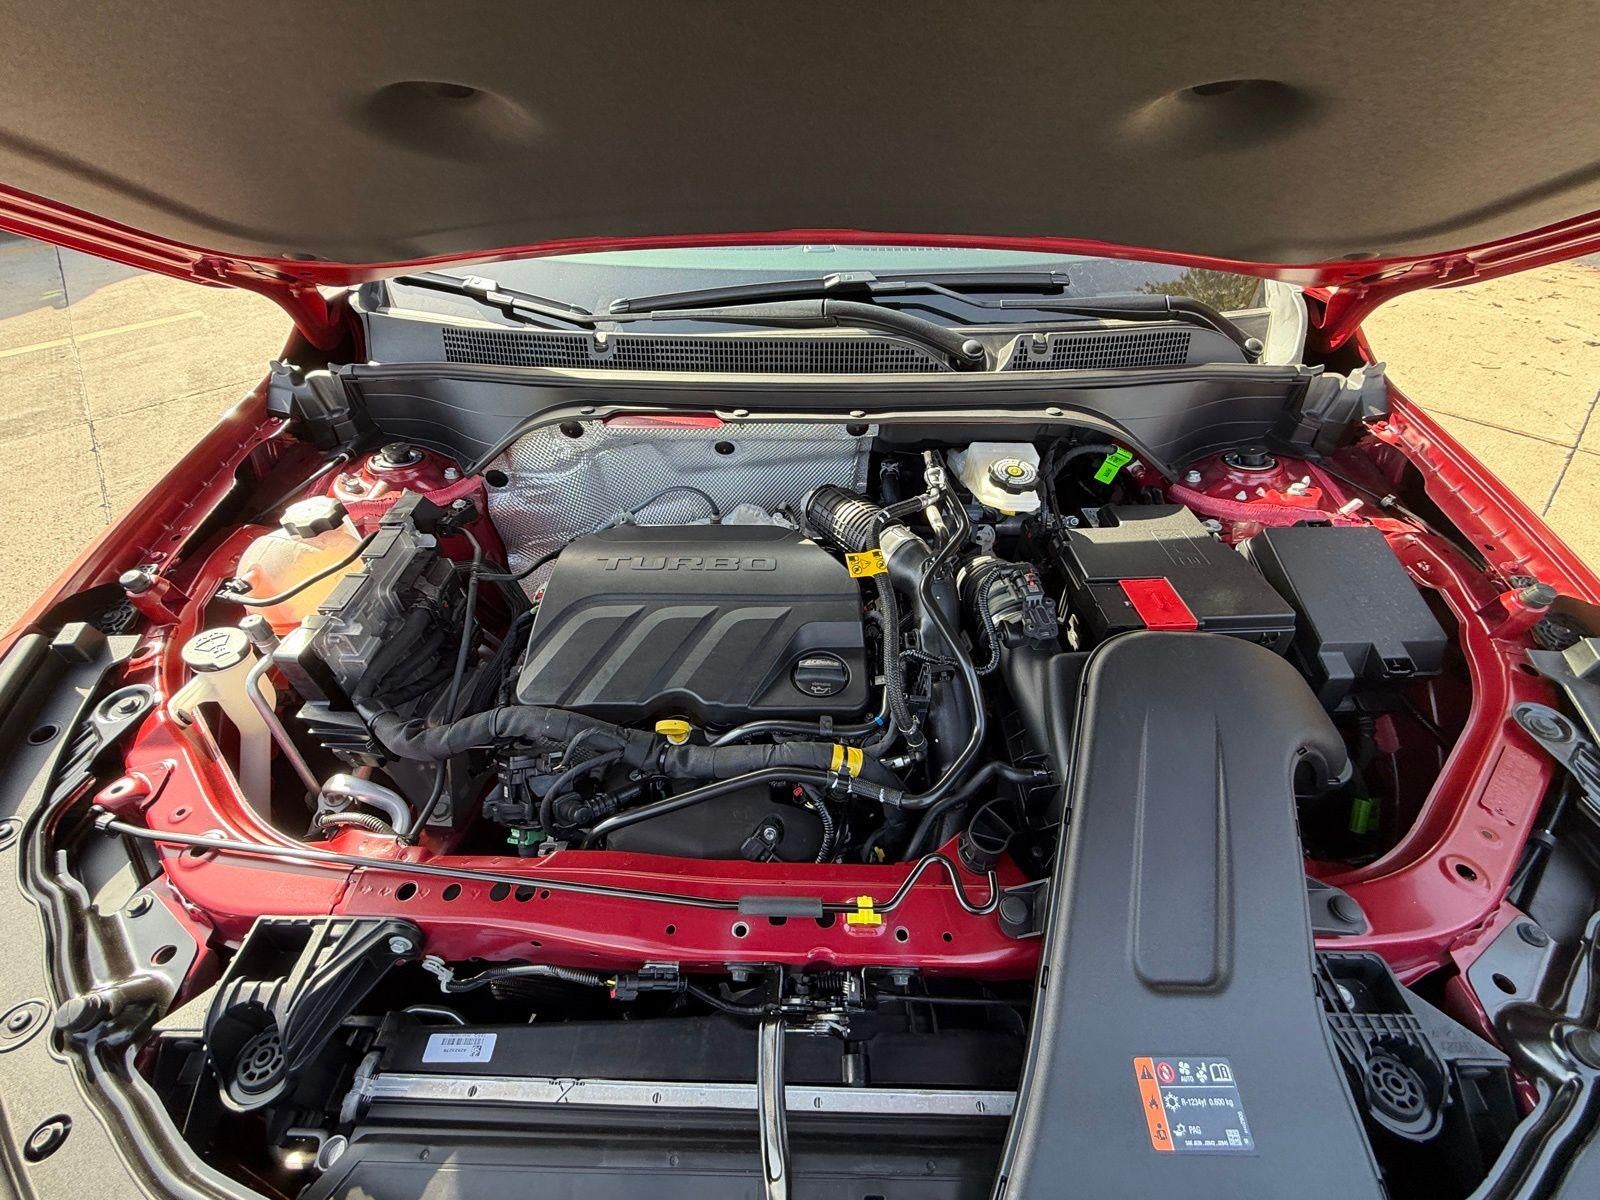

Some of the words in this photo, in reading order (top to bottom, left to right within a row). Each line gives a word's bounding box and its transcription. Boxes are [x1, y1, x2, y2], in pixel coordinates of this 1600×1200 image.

[597, 556, 777, 571] TURBO
[1225, 1098, 1234, 1108] kg
[1188, 1125, 1202, 1135] PAG
